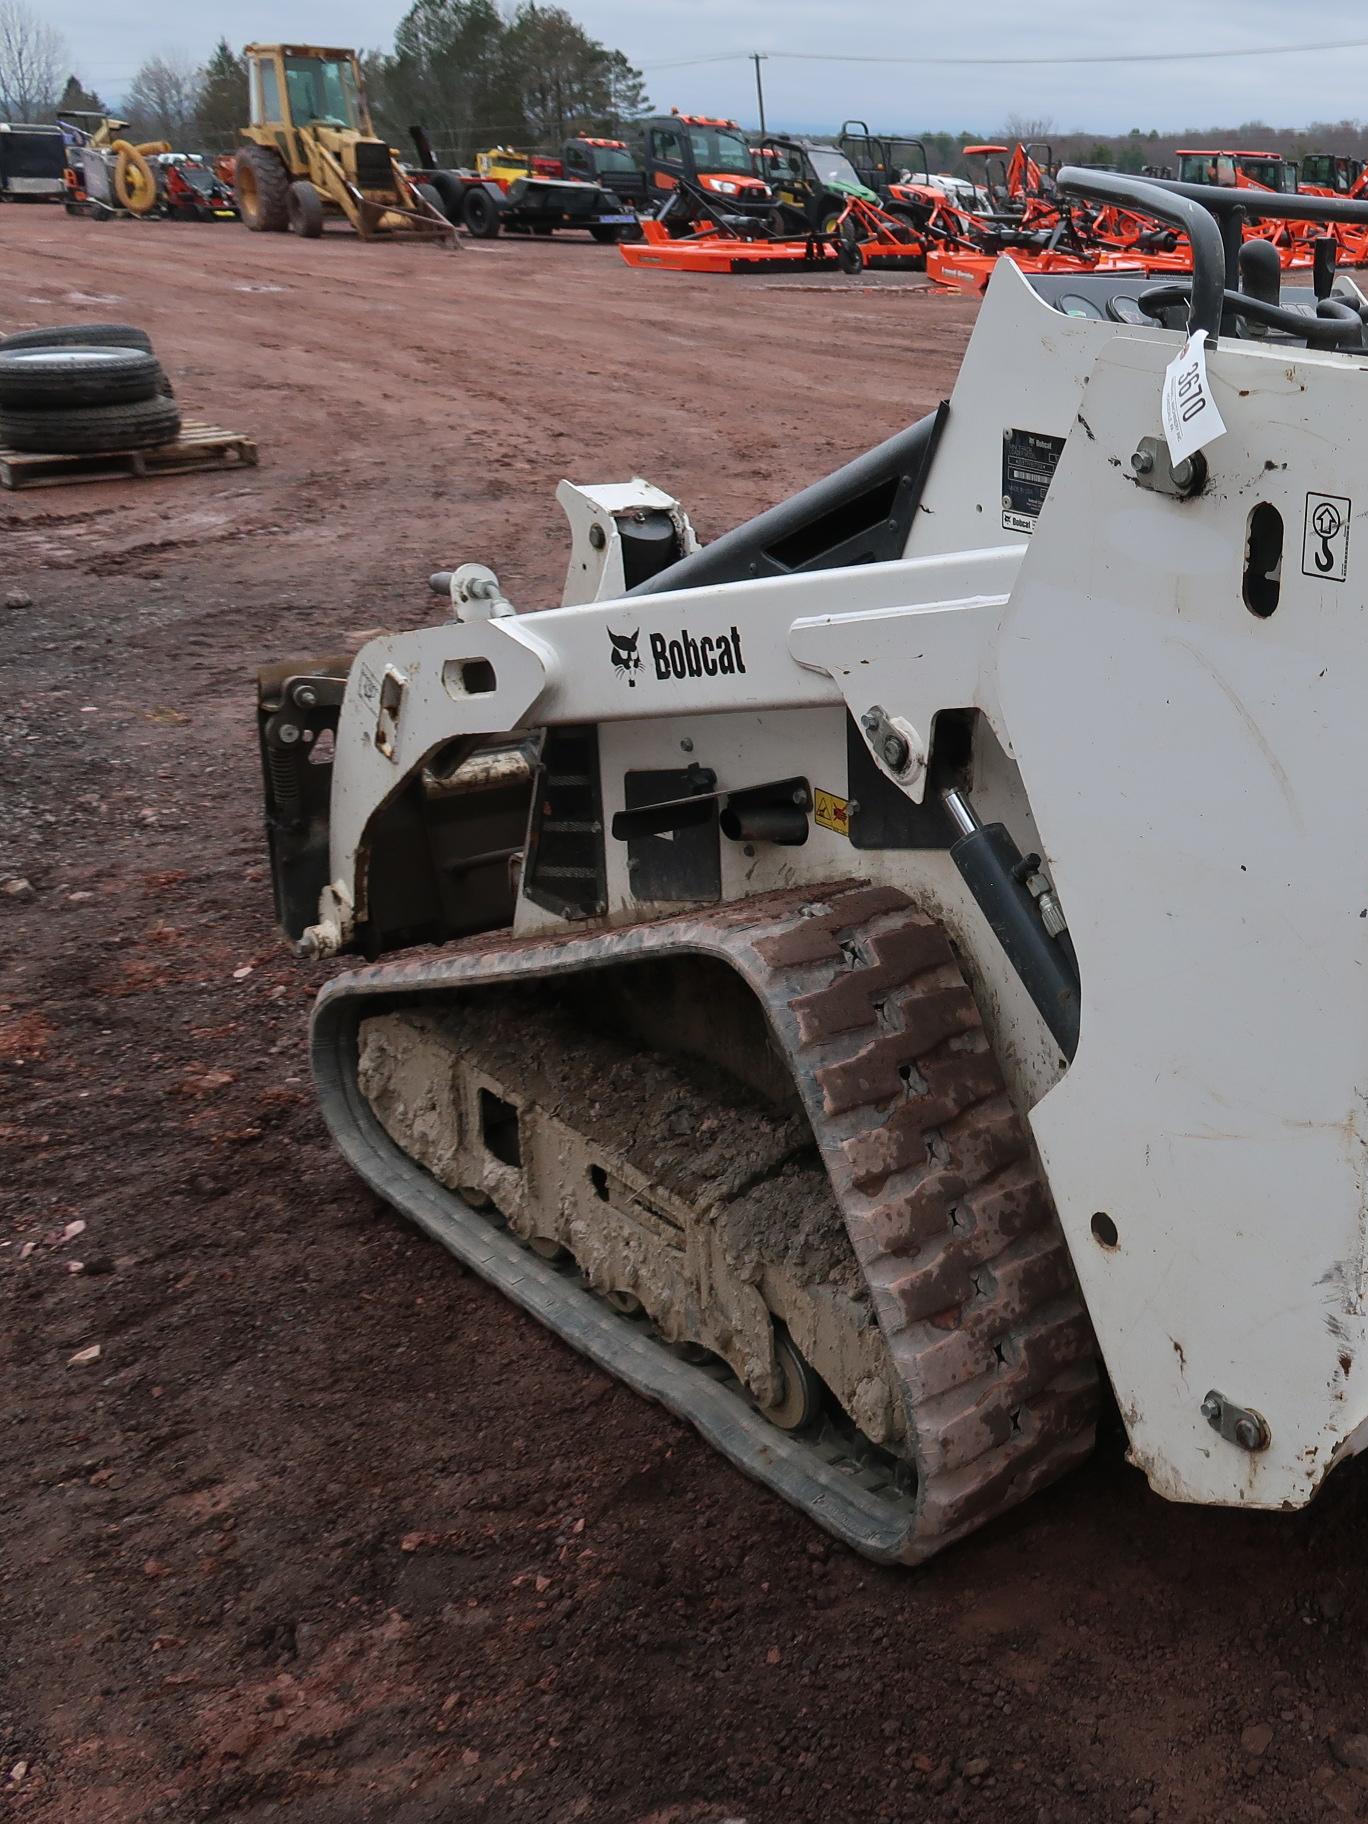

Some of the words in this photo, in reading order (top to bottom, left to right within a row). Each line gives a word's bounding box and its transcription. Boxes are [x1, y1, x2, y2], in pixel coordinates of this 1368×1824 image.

[1178, 361, 1206, 423] 3670
[1012, 516, 1031, 529] Bobcat
[648, 625, 747, 681] Bobcat
